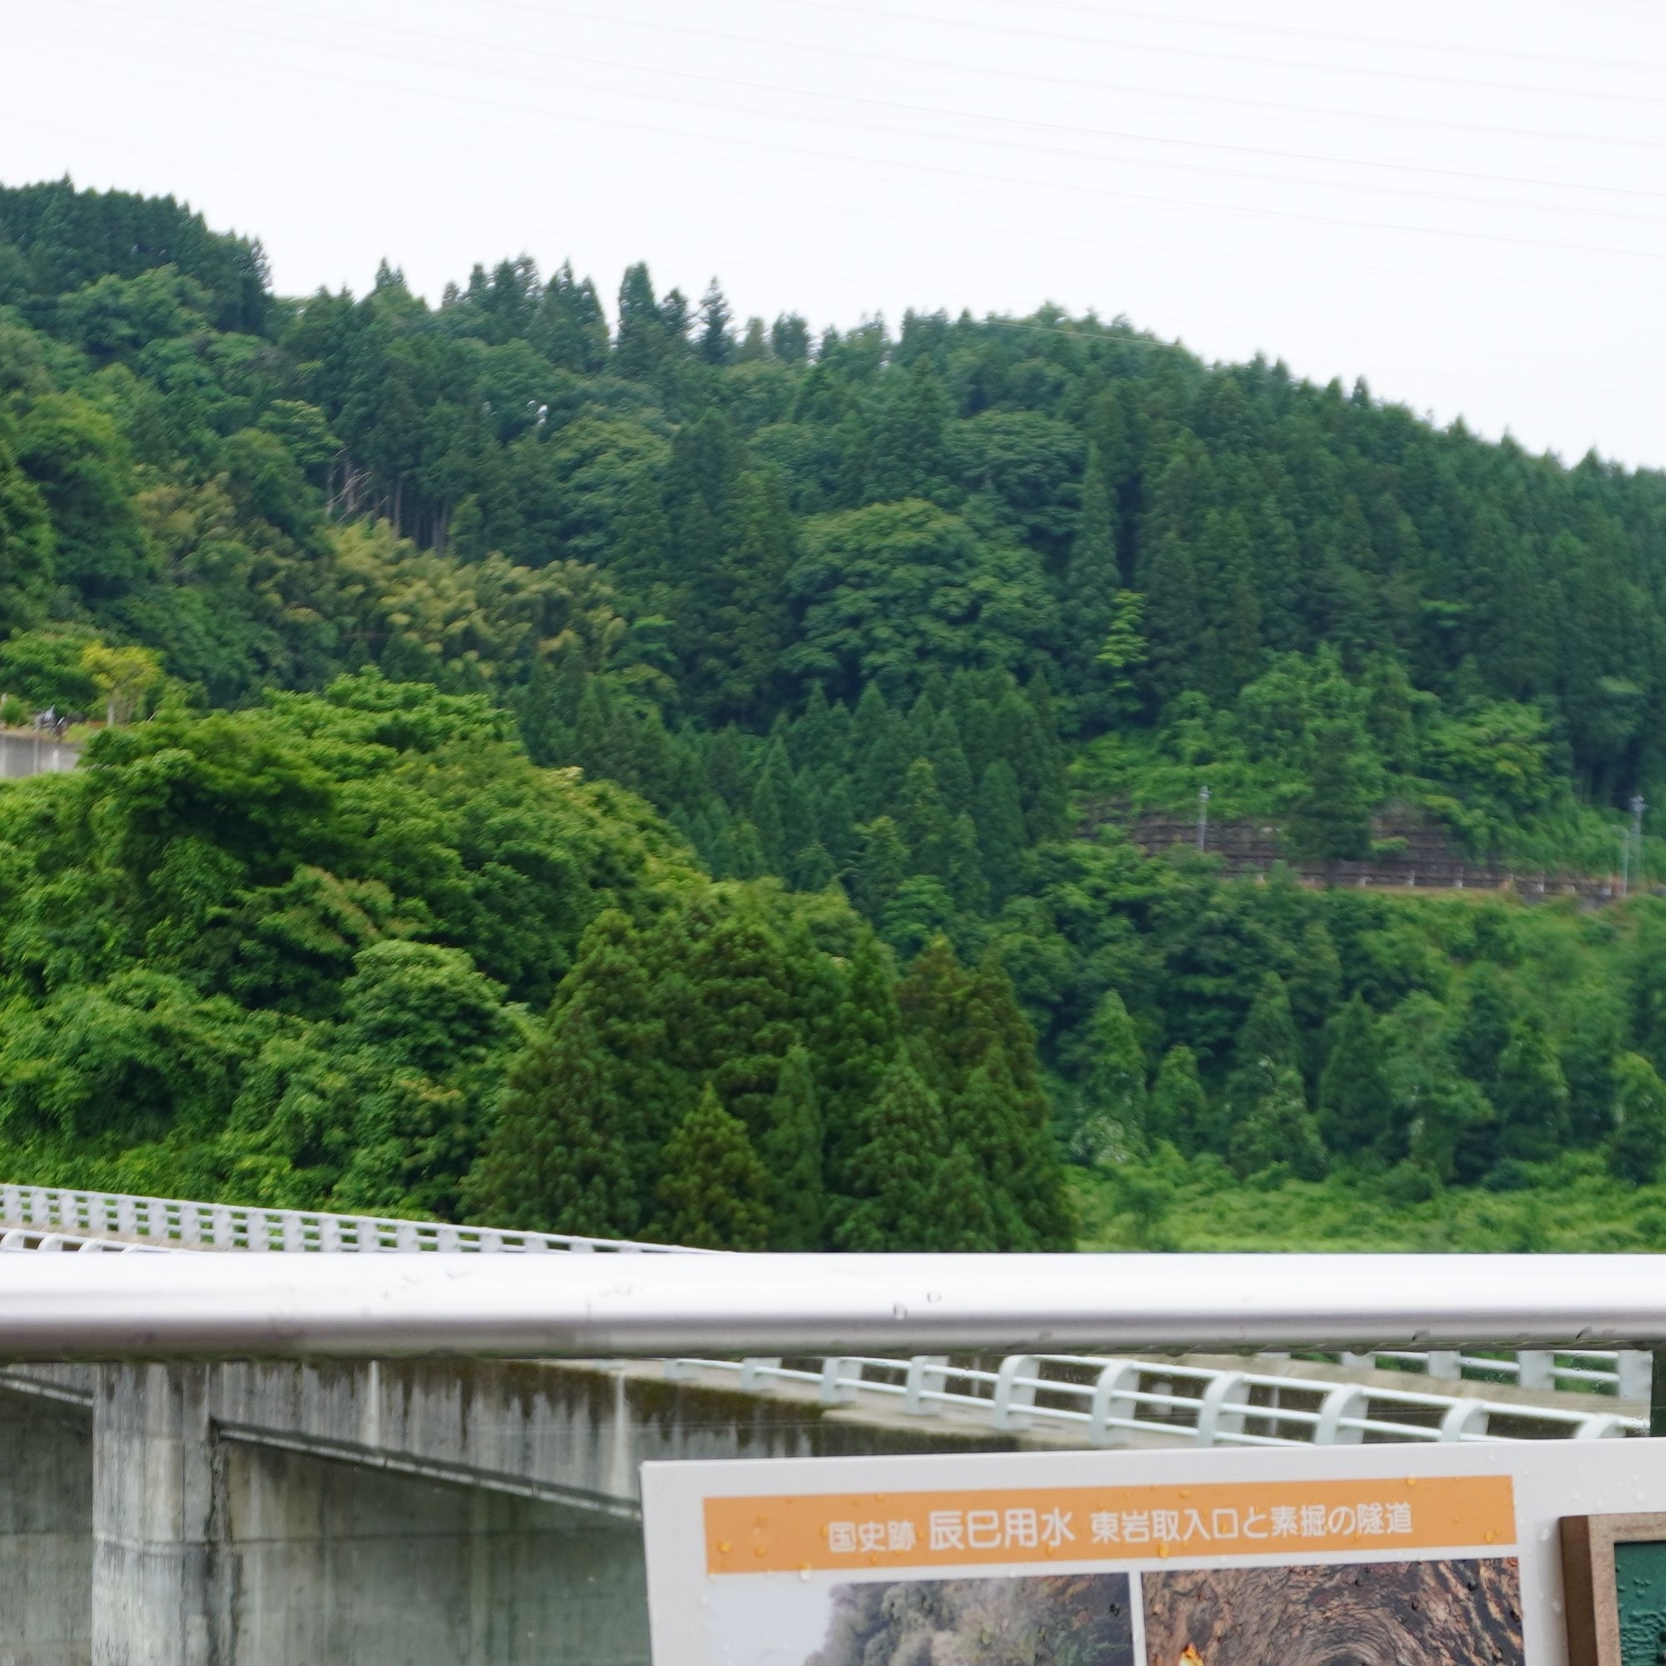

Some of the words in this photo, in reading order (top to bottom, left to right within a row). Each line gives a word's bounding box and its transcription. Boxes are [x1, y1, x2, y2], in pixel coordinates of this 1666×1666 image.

[828, 1519, 916, 1554] 国史跡
[928, 1508, 1076, 1552] 辰巳用水
[1091, 1502, 1413, 1546] 東岩取入口と素掘の隧道
